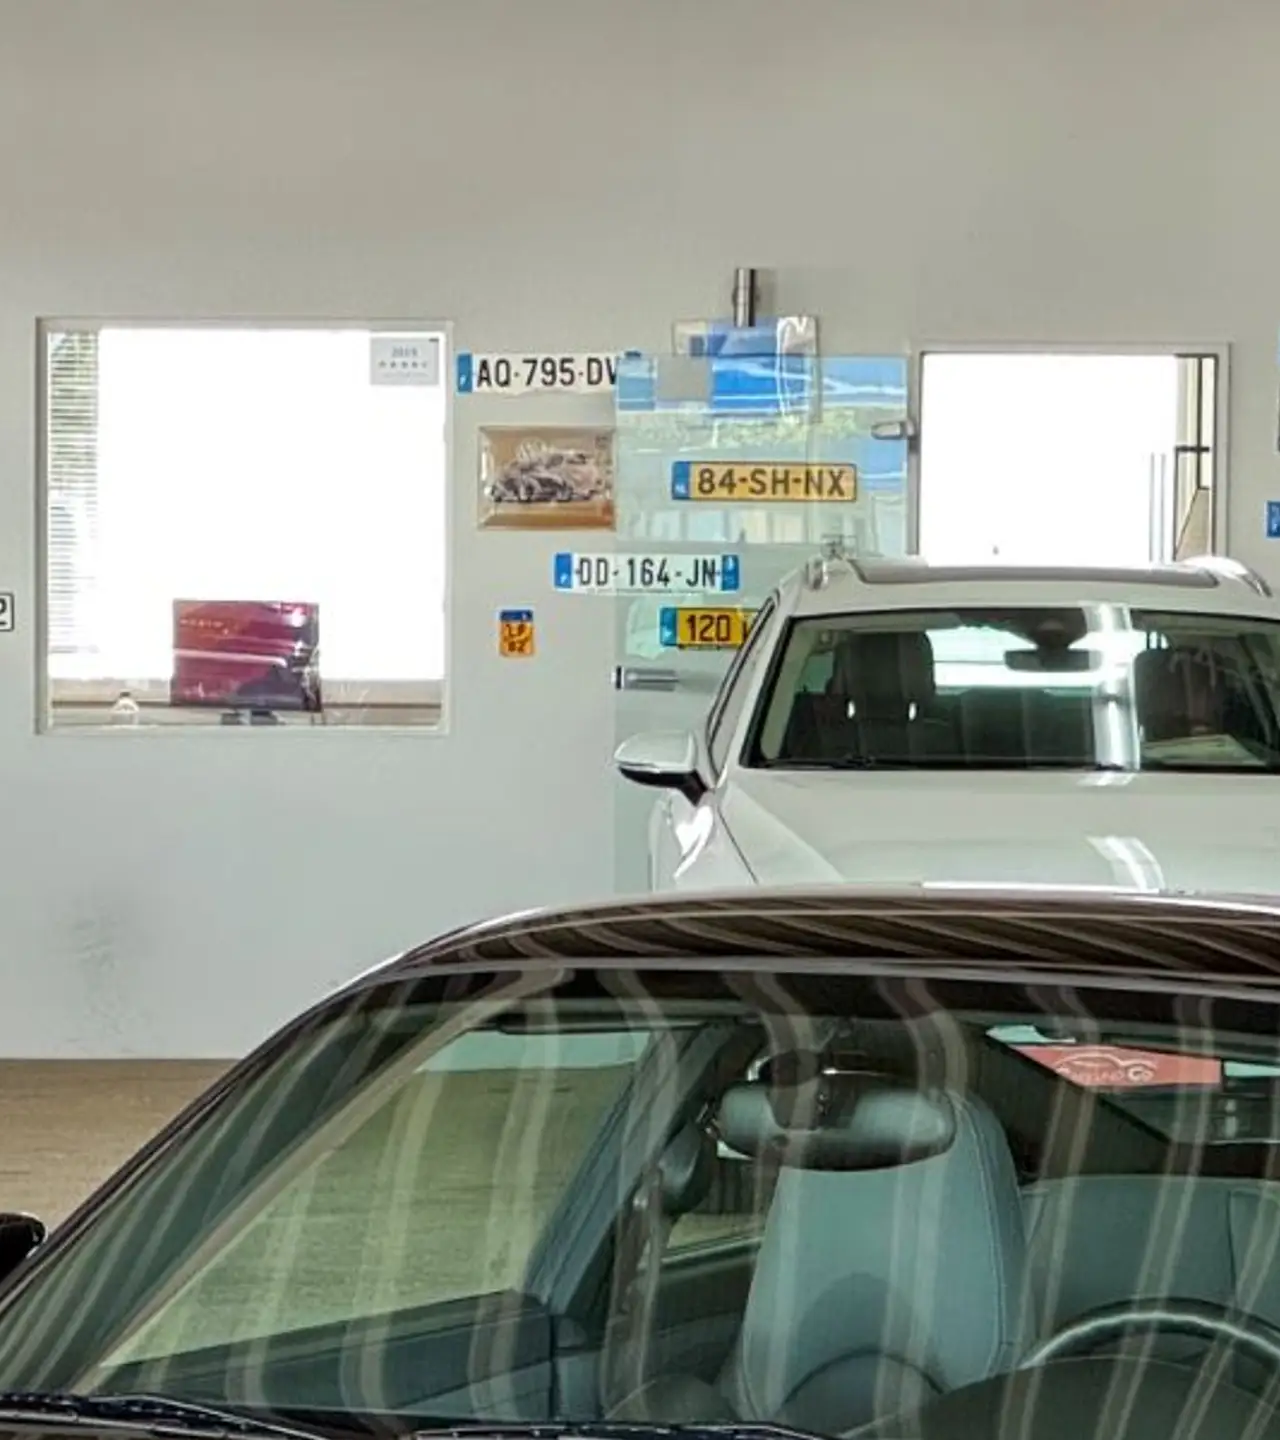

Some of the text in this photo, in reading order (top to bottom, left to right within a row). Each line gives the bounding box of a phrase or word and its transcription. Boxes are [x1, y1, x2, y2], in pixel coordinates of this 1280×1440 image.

[697, 467, 845, 496] 84-SH-NX
[579, 557, 716, 587] DD-164-JN
[686, 614, 731, 642] 120
